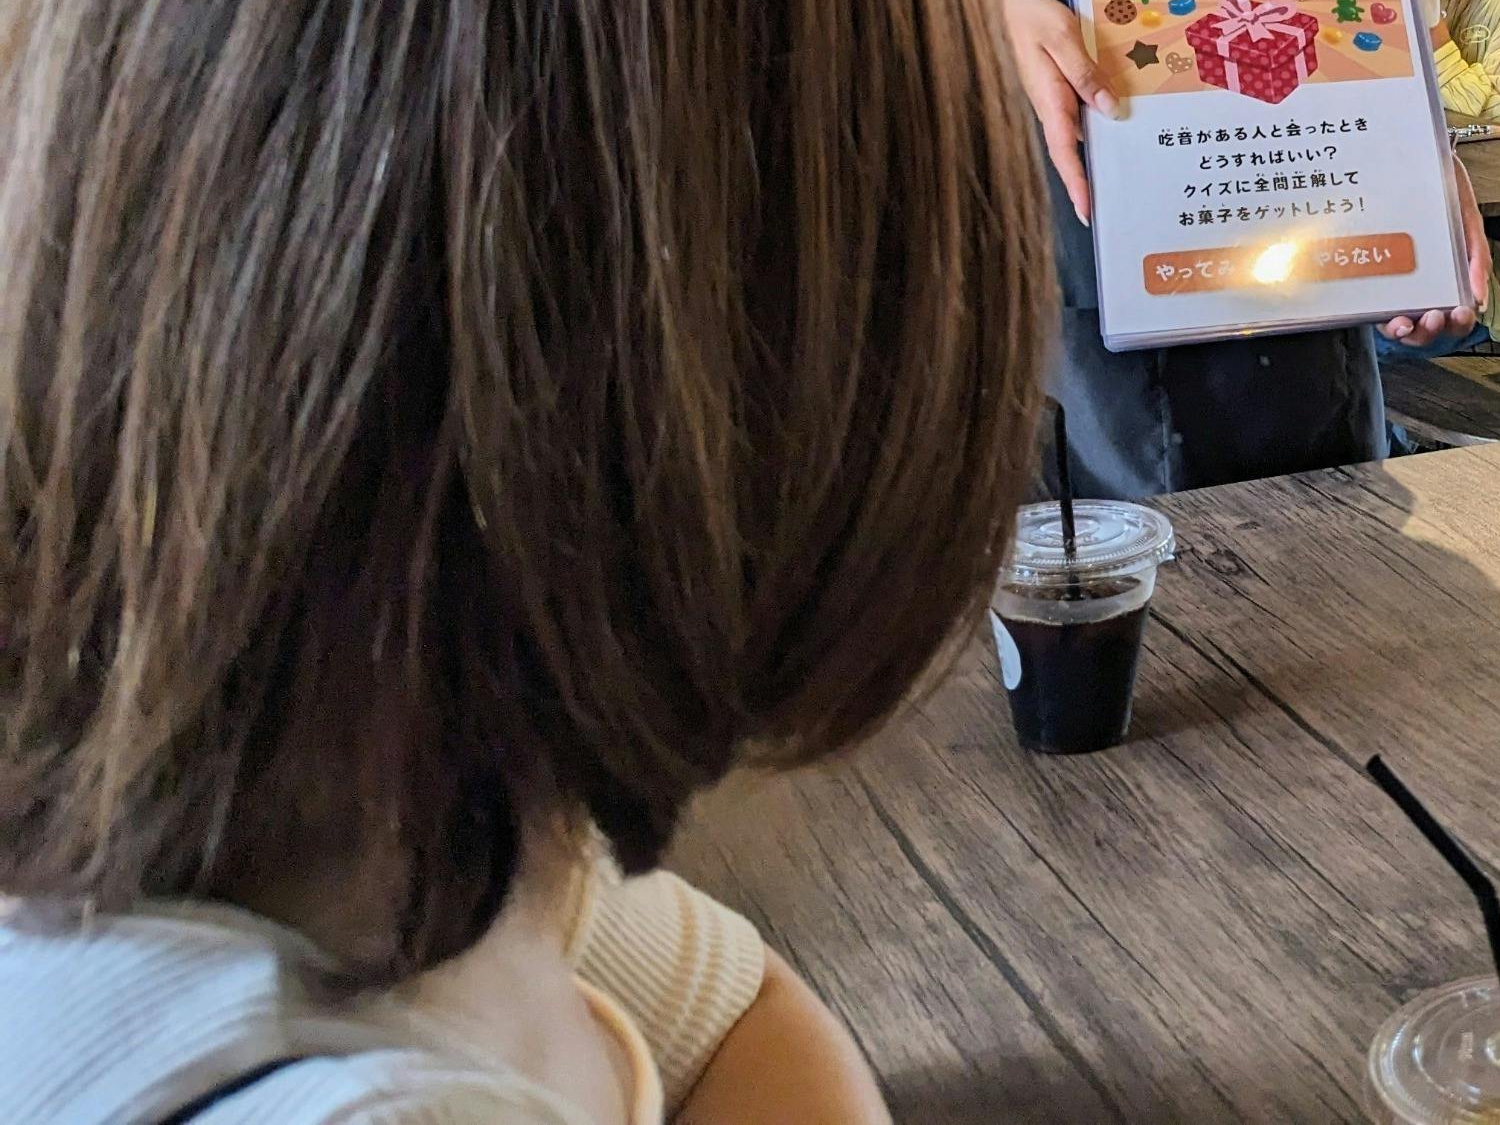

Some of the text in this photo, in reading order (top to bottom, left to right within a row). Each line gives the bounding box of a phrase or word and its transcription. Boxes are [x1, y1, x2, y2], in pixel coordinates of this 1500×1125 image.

[1158, 118, 1369, 147] 吃音がある人と会ったとき
[1199, 146, 1337, 170] どうすればいい？
[1183, 171, 1360, 198] クイズに全問正解して
[1178, 197, 1366, 226] お菓子をゲットしよう！
[1155, 259, 1254, 282] やってみ
